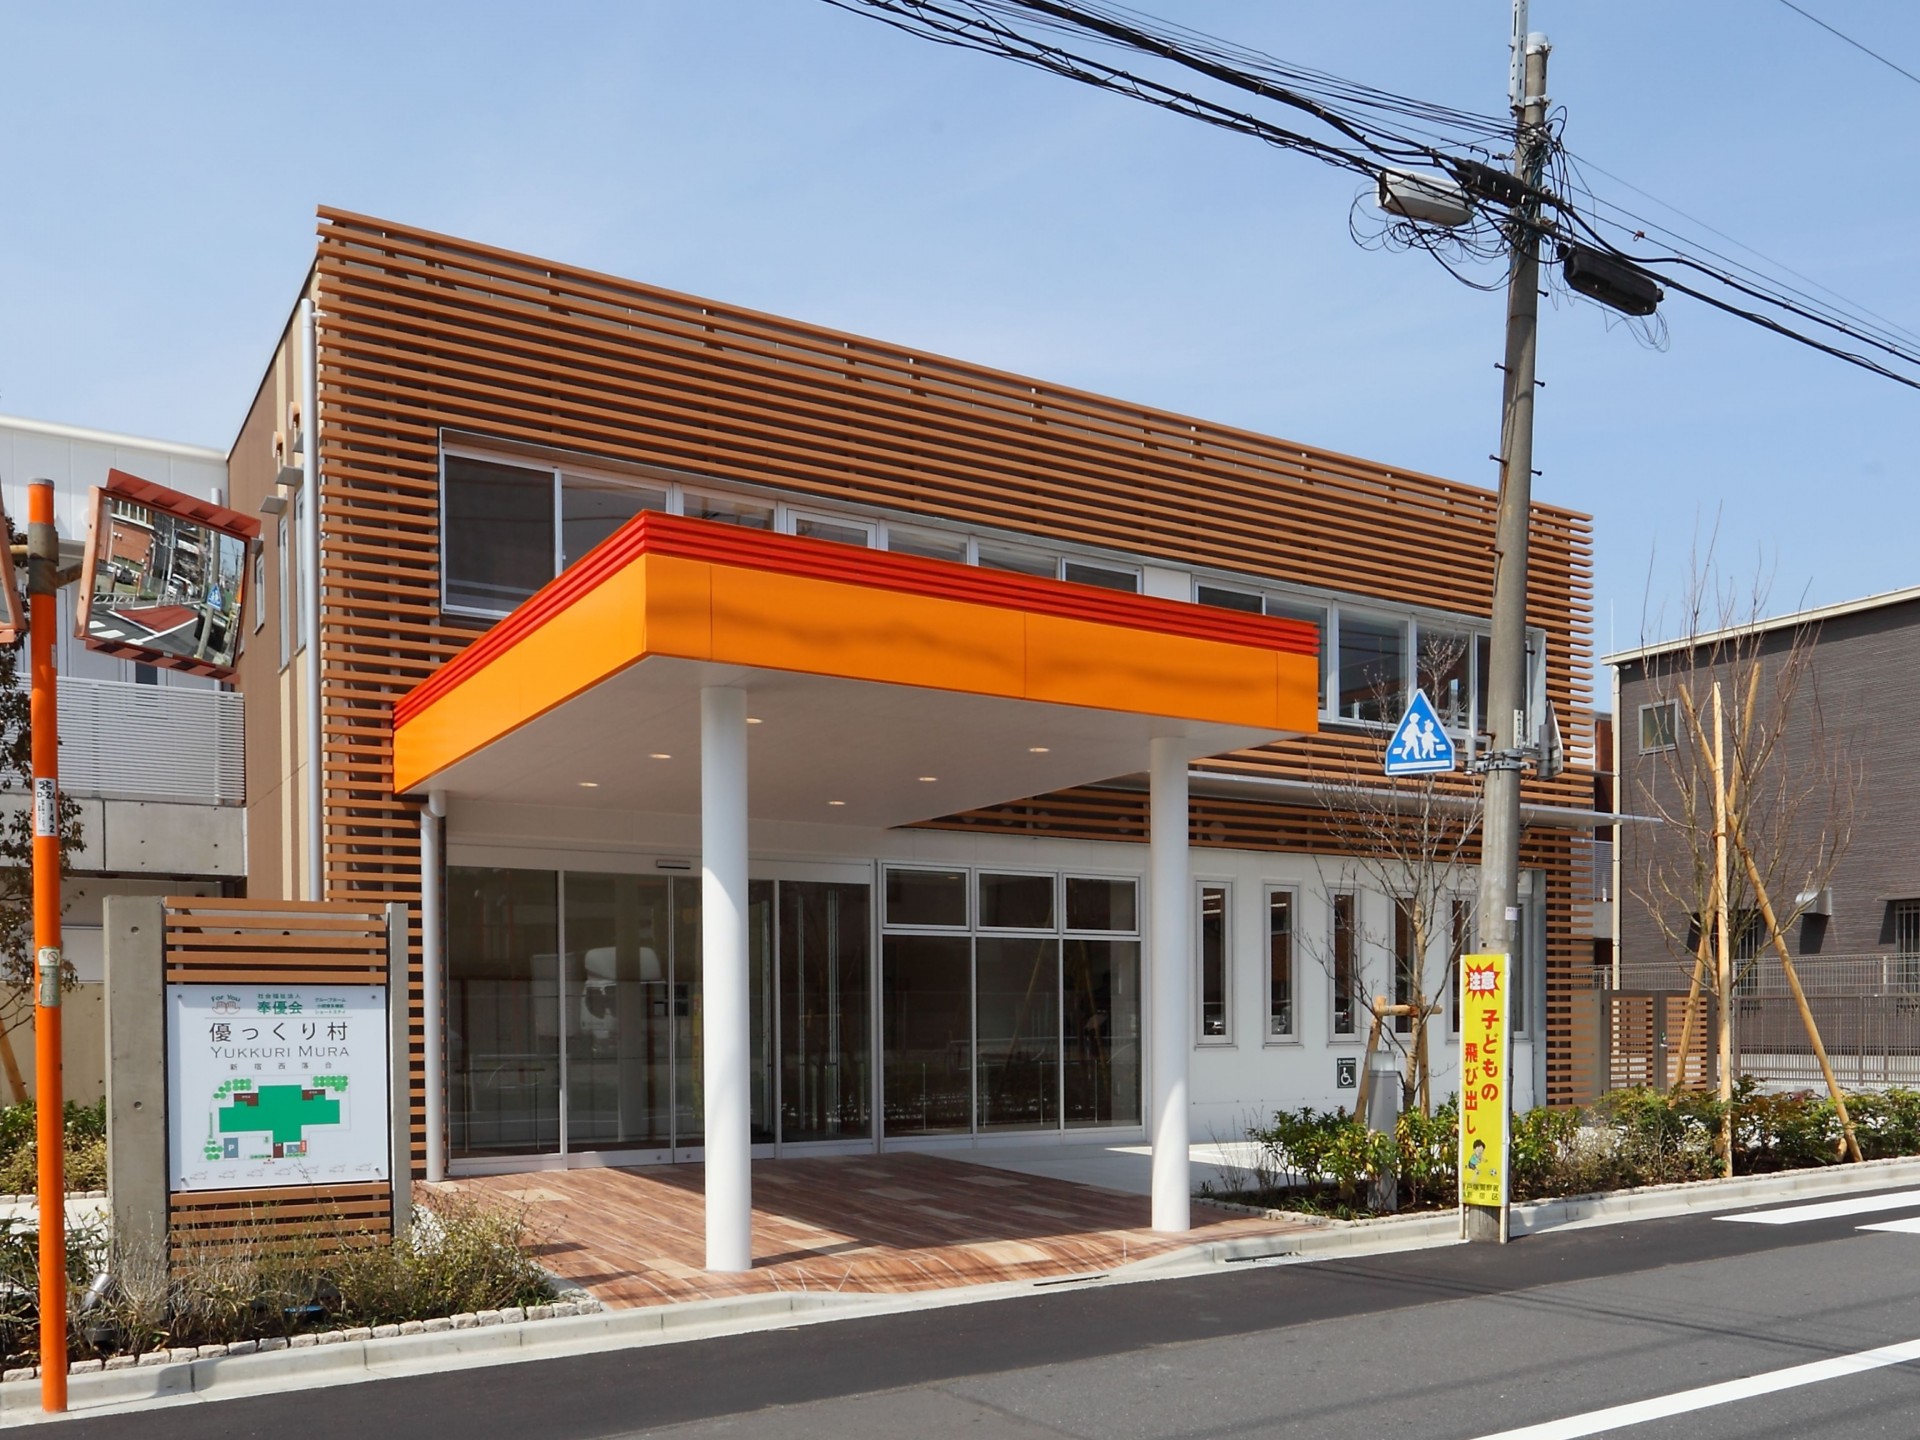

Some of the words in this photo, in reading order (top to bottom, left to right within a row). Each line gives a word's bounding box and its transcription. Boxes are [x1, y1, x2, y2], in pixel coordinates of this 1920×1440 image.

[1469, 971, 1495, 990] 注意
[227, 994, 241, 1002] You
[257, 1001, 303, 1015] 奉優会
[209, 1021, 348, 1042] 優っくり村
[210, 1046, 290, 1059] YUKKURI
[298, 1045, 350, 1058] MURA
[1481, 1009, 1500, 1101] 子どもの
[1465, 1042, 1479, 1135] 飛び出し
[228, 1144, 235, 1152] P
